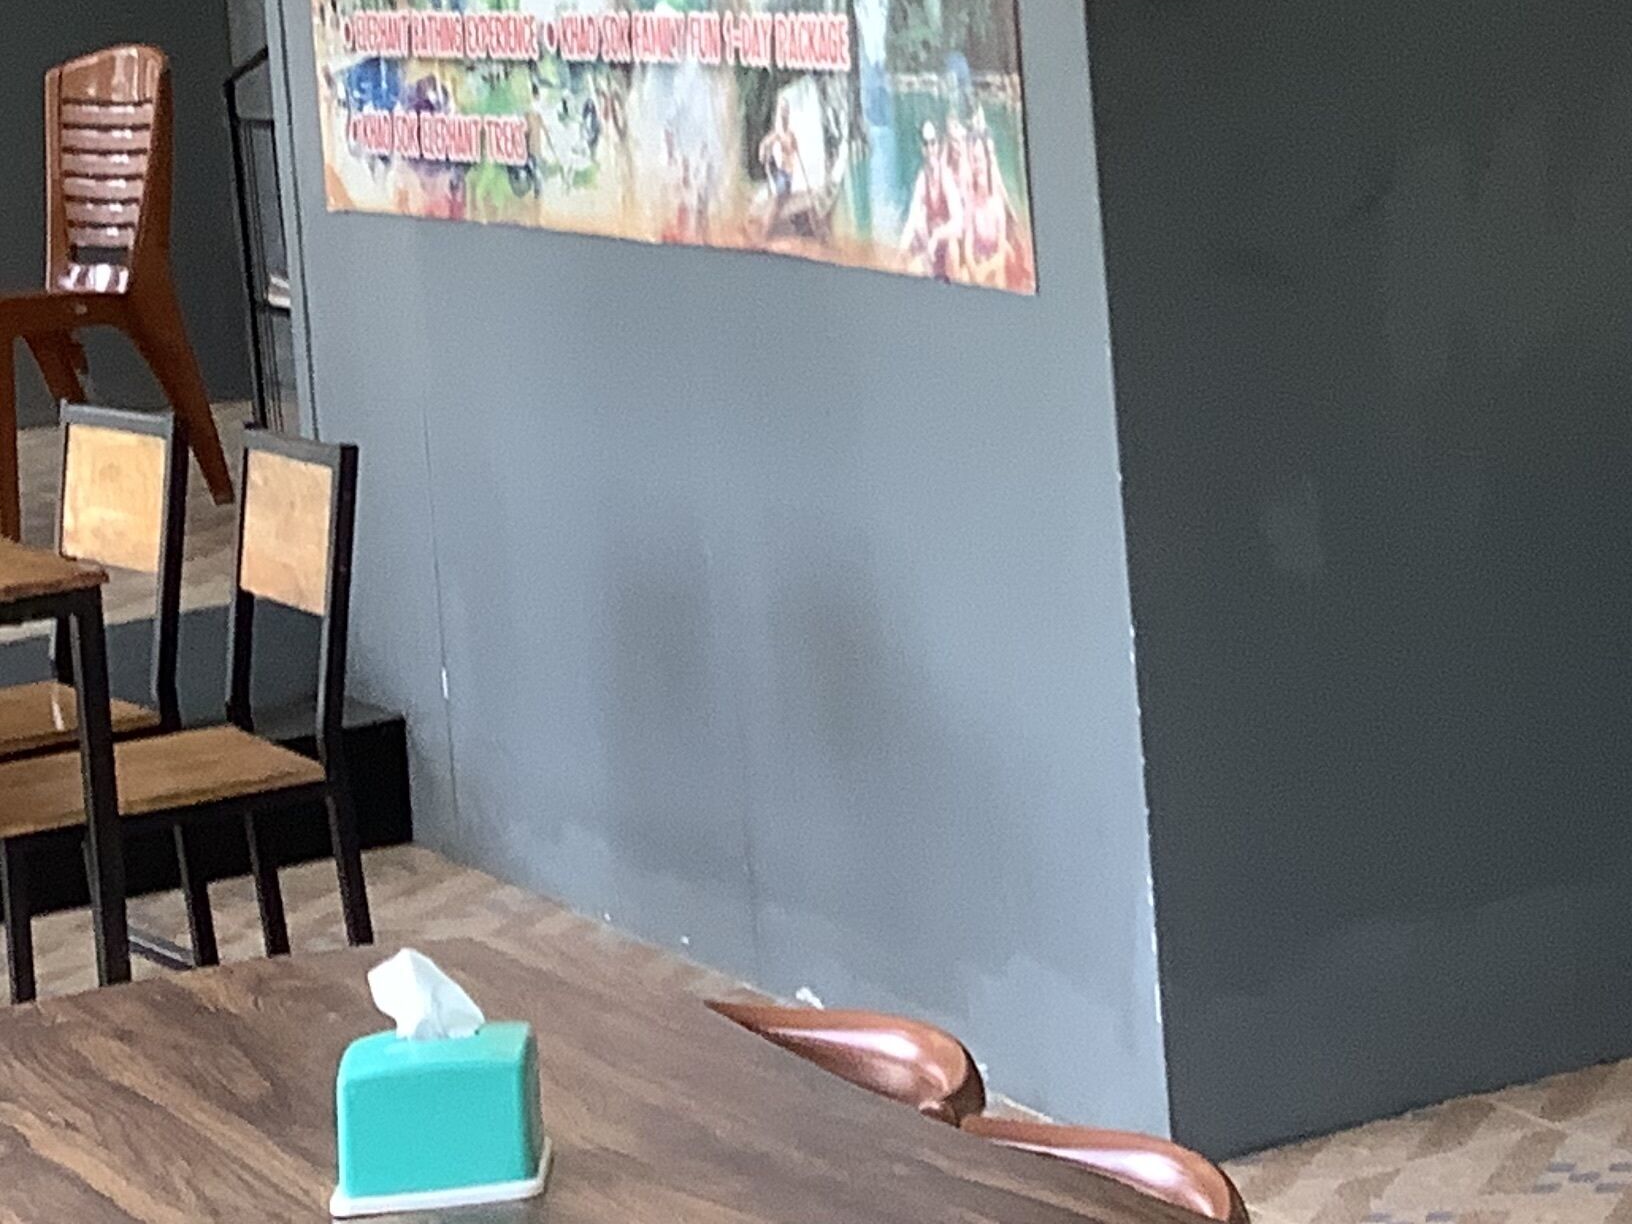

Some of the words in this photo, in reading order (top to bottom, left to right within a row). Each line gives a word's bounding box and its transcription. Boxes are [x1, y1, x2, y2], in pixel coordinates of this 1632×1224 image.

[354, 10, 410, 57] ELEPHANT
[559, 13, 599, 61] KHAO
[601, 13, 631, 62] SOK
[632, 12, 685, 63] FAMILY
[686, 12, 720, 64] FUN
[774, 13, 850, 70] PACKAGE
